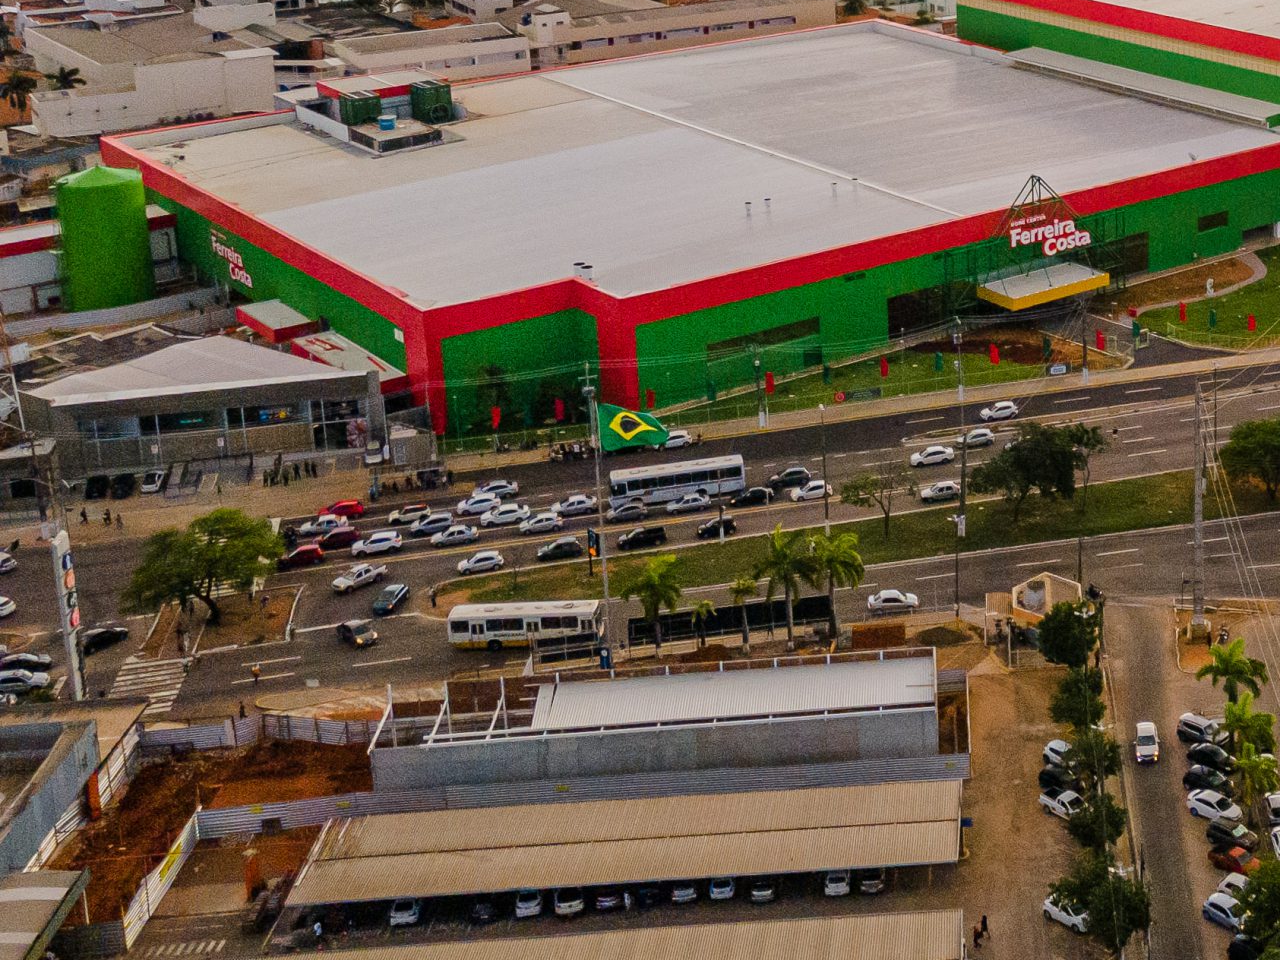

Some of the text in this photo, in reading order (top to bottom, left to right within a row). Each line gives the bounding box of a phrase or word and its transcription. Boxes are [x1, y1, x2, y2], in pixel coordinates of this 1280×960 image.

[1010, 218, 1076, 248] Ferreira
[1043, 230, 1092, 256] Costa
[211, 235, 244, 268] Ferreira
[229, 262, 253, 288] Costa
